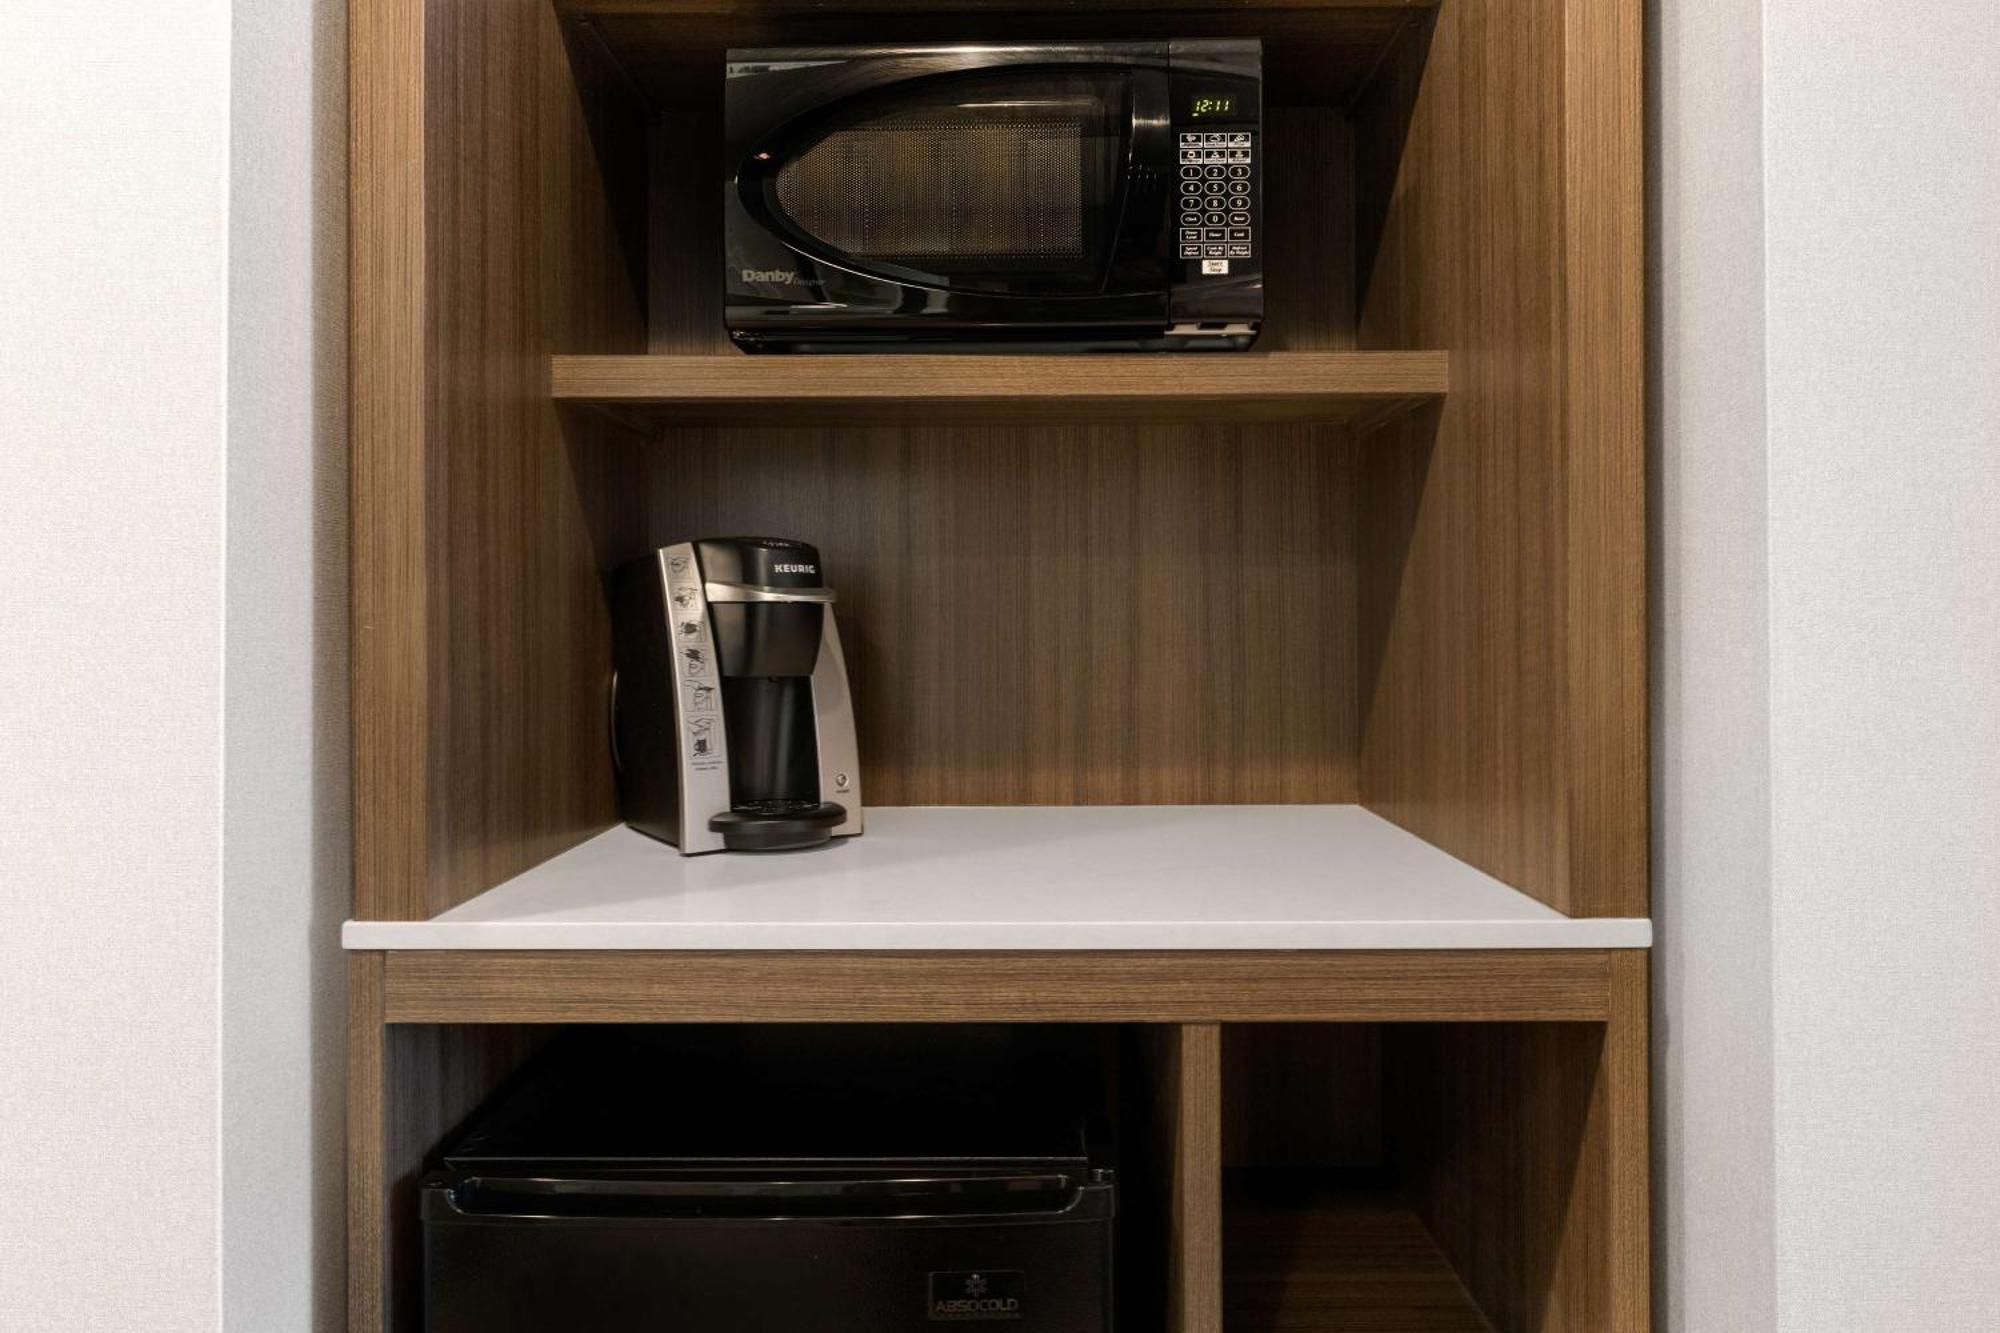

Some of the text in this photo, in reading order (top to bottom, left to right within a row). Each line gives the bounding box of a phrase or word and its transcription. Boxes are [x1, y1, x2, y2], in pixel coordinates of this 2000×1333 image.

[1195, 99, 1230, 113] 12:11
[1212, 168, 1218, 177] 2
[1236, 168, 1242, 177] 3
[1188, 184, 1242, 192] 4 5 6
[1188, 199, 1242, 207] 7 8 9
[1212, 215, 1219, 223] 0
[742, 269, 795, 285] Danby
[774, 564, 816, 574] KEURIG
[934, 1298, 1019, 1313] ABSOCOLD
